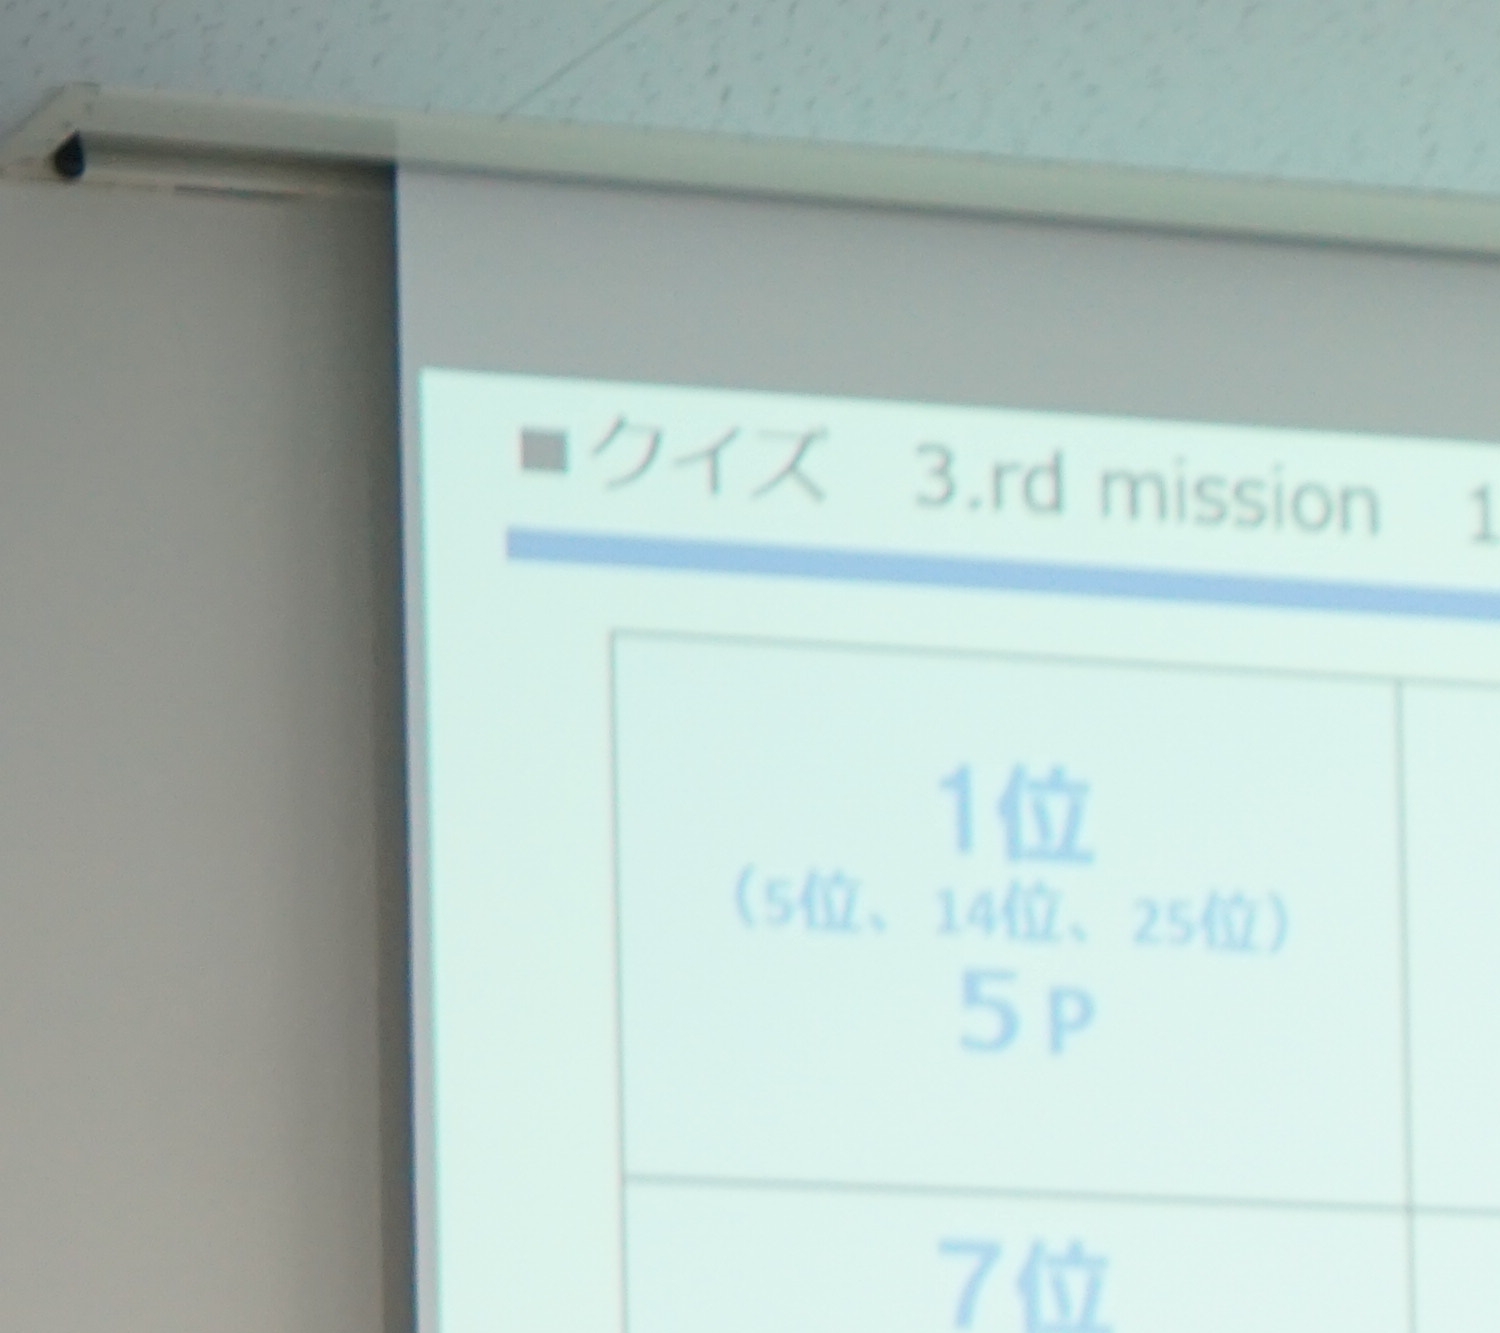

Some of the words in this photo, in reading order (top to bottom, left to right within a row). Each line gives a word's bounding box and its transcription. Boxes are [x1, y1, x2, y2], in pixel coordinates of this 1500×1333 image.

[589, 414, 830, 504] クイズ
[912, 443, 1068, 516] 3.rd
[1099, 461, 1381, 536] mission
[938, 763, 1094, 866] 1位
